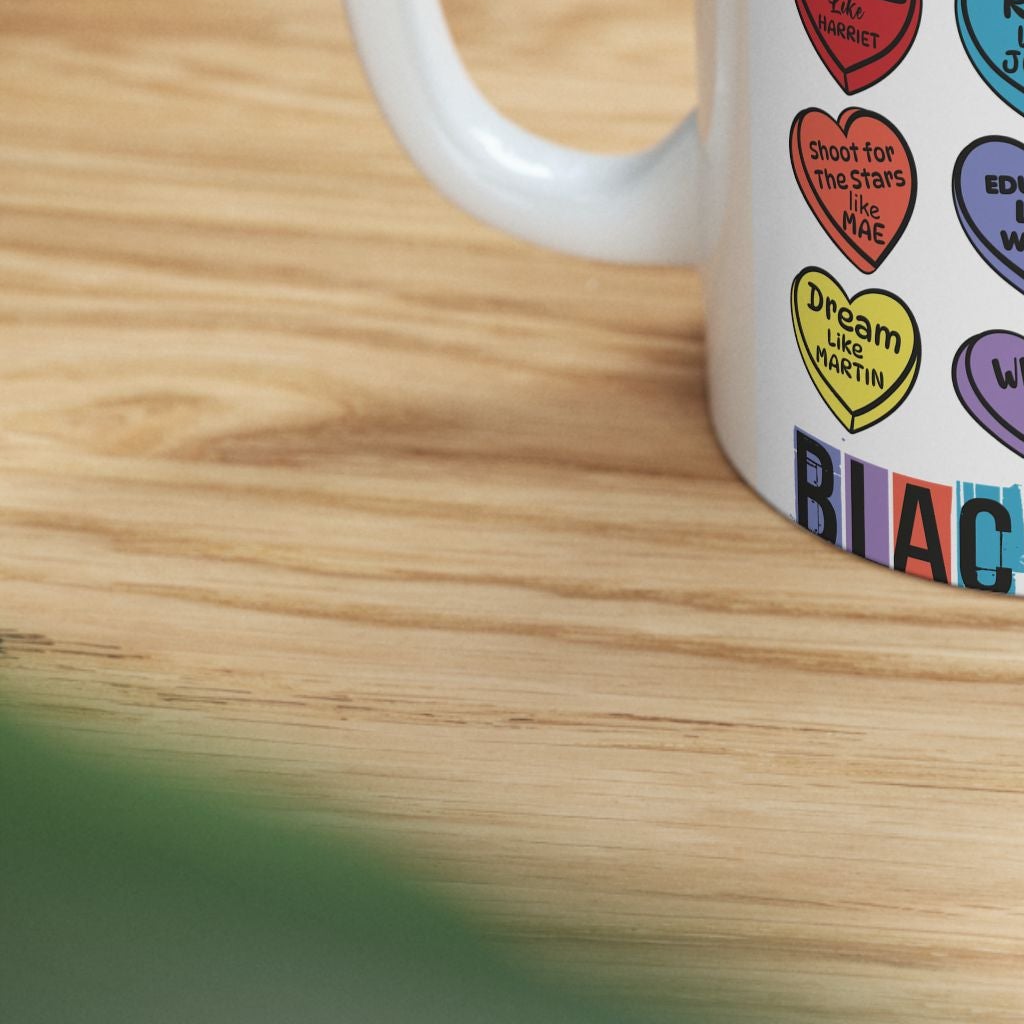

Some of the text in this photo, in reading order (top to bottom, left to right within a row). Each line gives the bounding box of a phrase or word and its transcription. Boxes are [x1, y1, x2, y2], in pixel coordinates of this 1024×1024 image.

[818, 14, 880, 49] HARRIET
[810, 141, 895, 163] Shoot for
[814, 168, 906, 191] The Stars
[850, 191, 880, 220] like
[842, 212, 886, 245] MAE
[807, 281, 902, 355] Dream
[827, 329, 863, 359] Like
[816, 346, 884, 390] MARTIN
